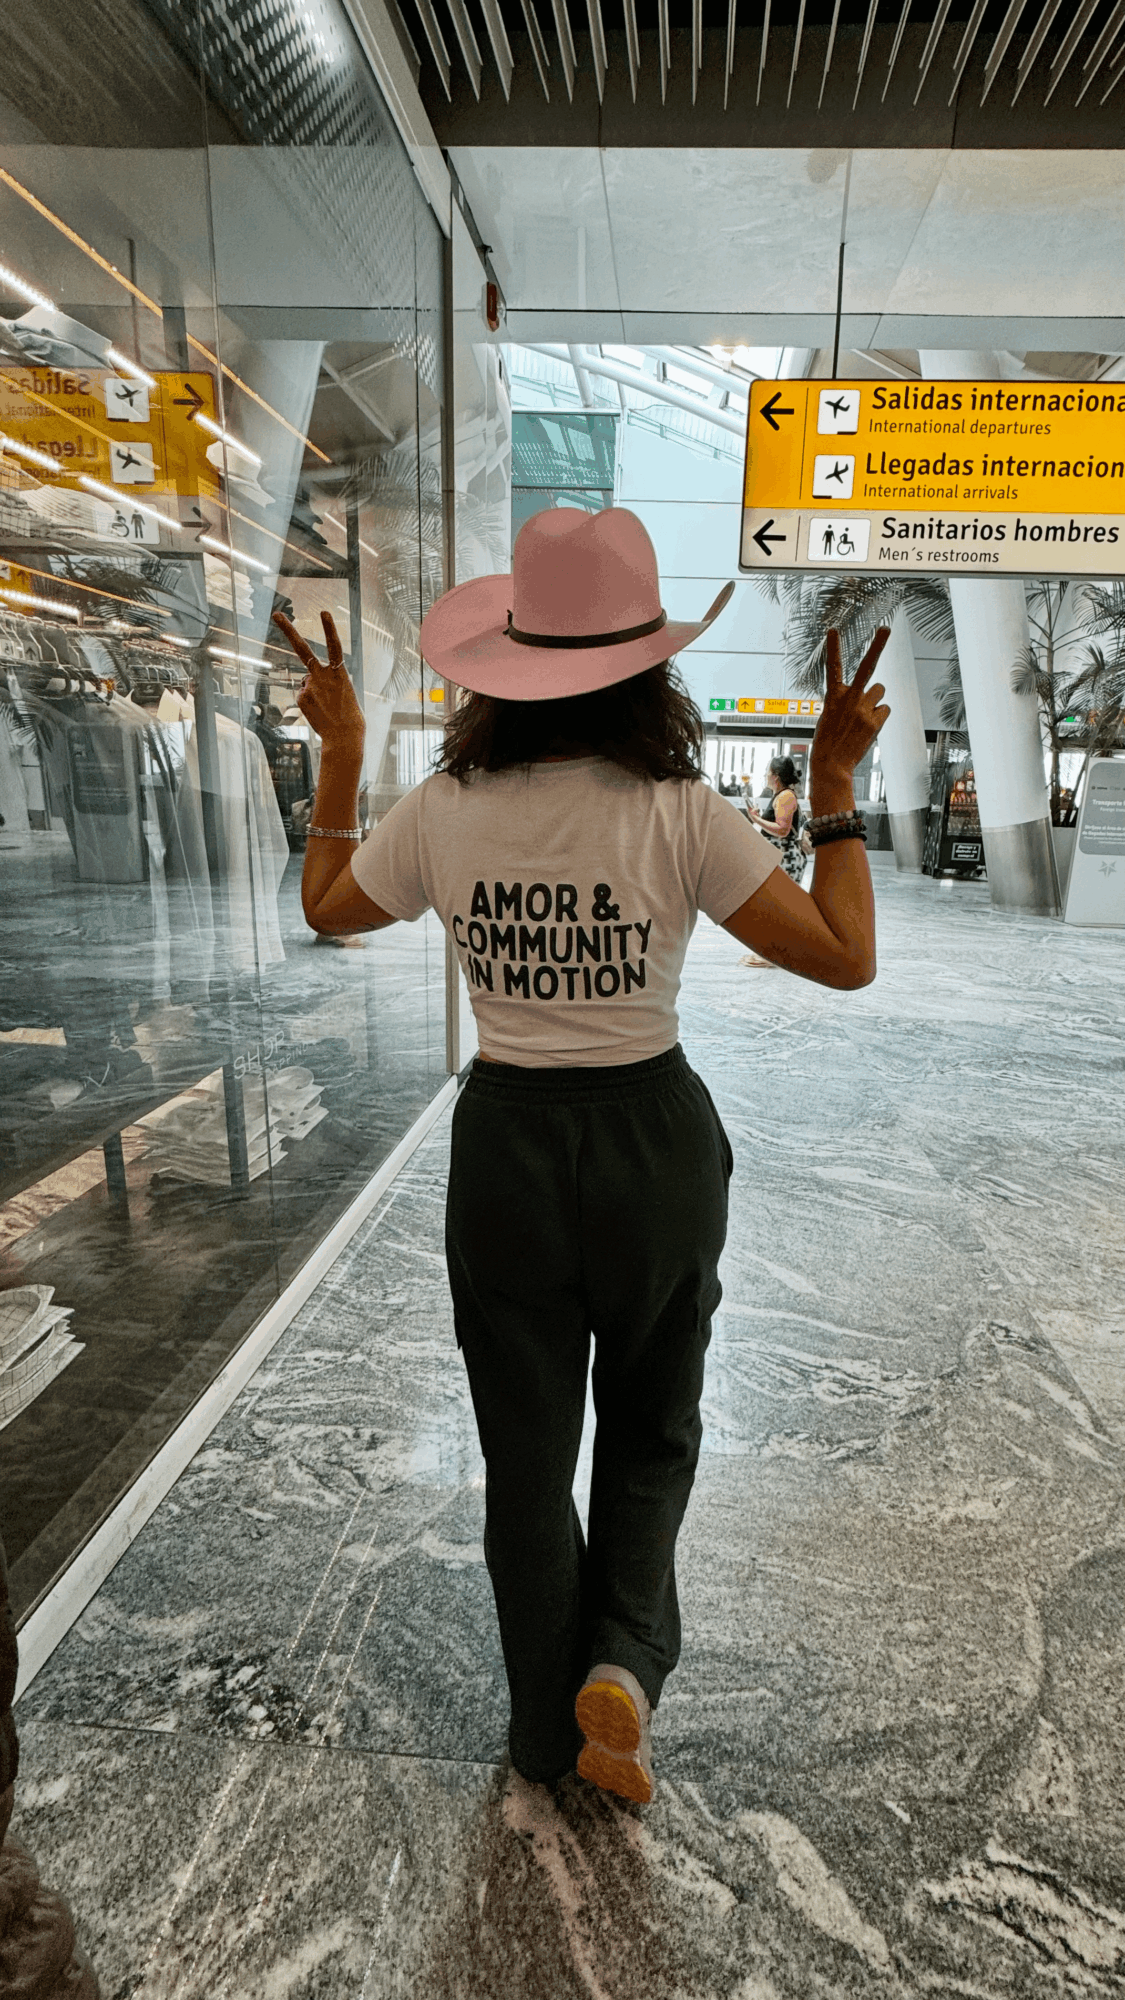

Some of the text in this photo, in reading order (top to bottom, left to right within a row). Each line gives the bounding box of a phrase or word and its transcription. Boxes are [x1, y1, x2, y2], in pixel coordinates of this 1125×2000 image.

[871, 385, 963, 411] Salidas
[868, 418, 1051, 438] International departures
[866, 451, 1125, 482] Llegadas internacion
[863, 483, 1018, 500] International arrivals
[881, 516, 1120, 543] Sanitarios hombres
[927, 549, 1000, 564] restrooms
[470, 880, 621, 923] AMOR &
[452, 914, 652, 964] COMMUNITY
[467, 953, 646, 1001] IN MOTION
